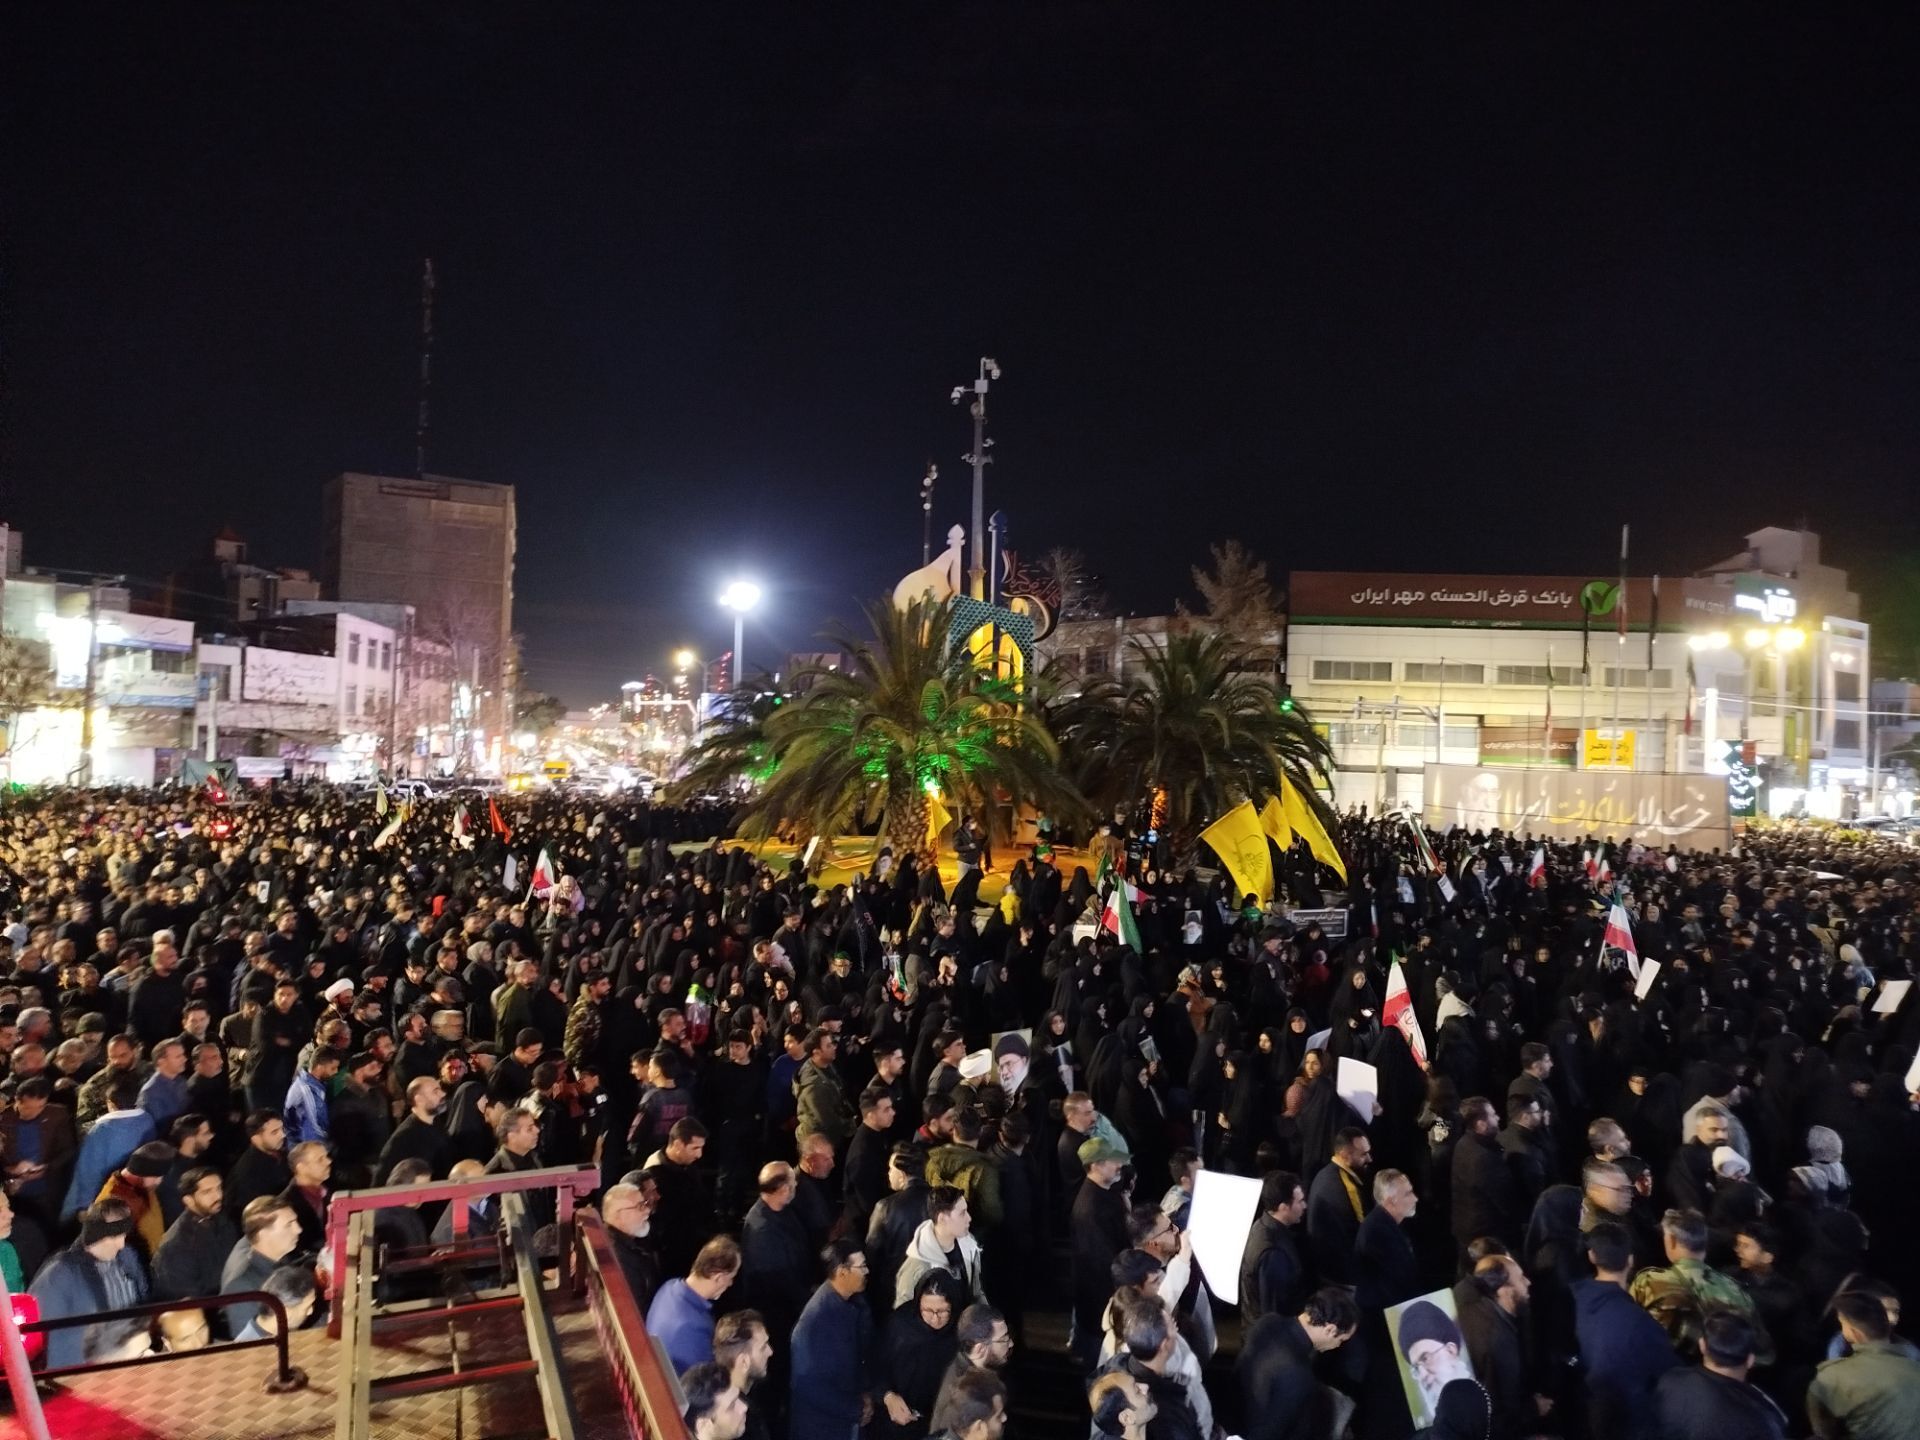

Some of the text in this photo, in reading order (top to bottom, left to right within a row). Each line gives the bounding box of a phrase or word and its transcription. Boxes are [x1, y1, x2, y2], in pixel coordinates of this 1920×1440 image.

[1350, 587, 1573, 609] بانک قرض الحسنه مهر ایران
